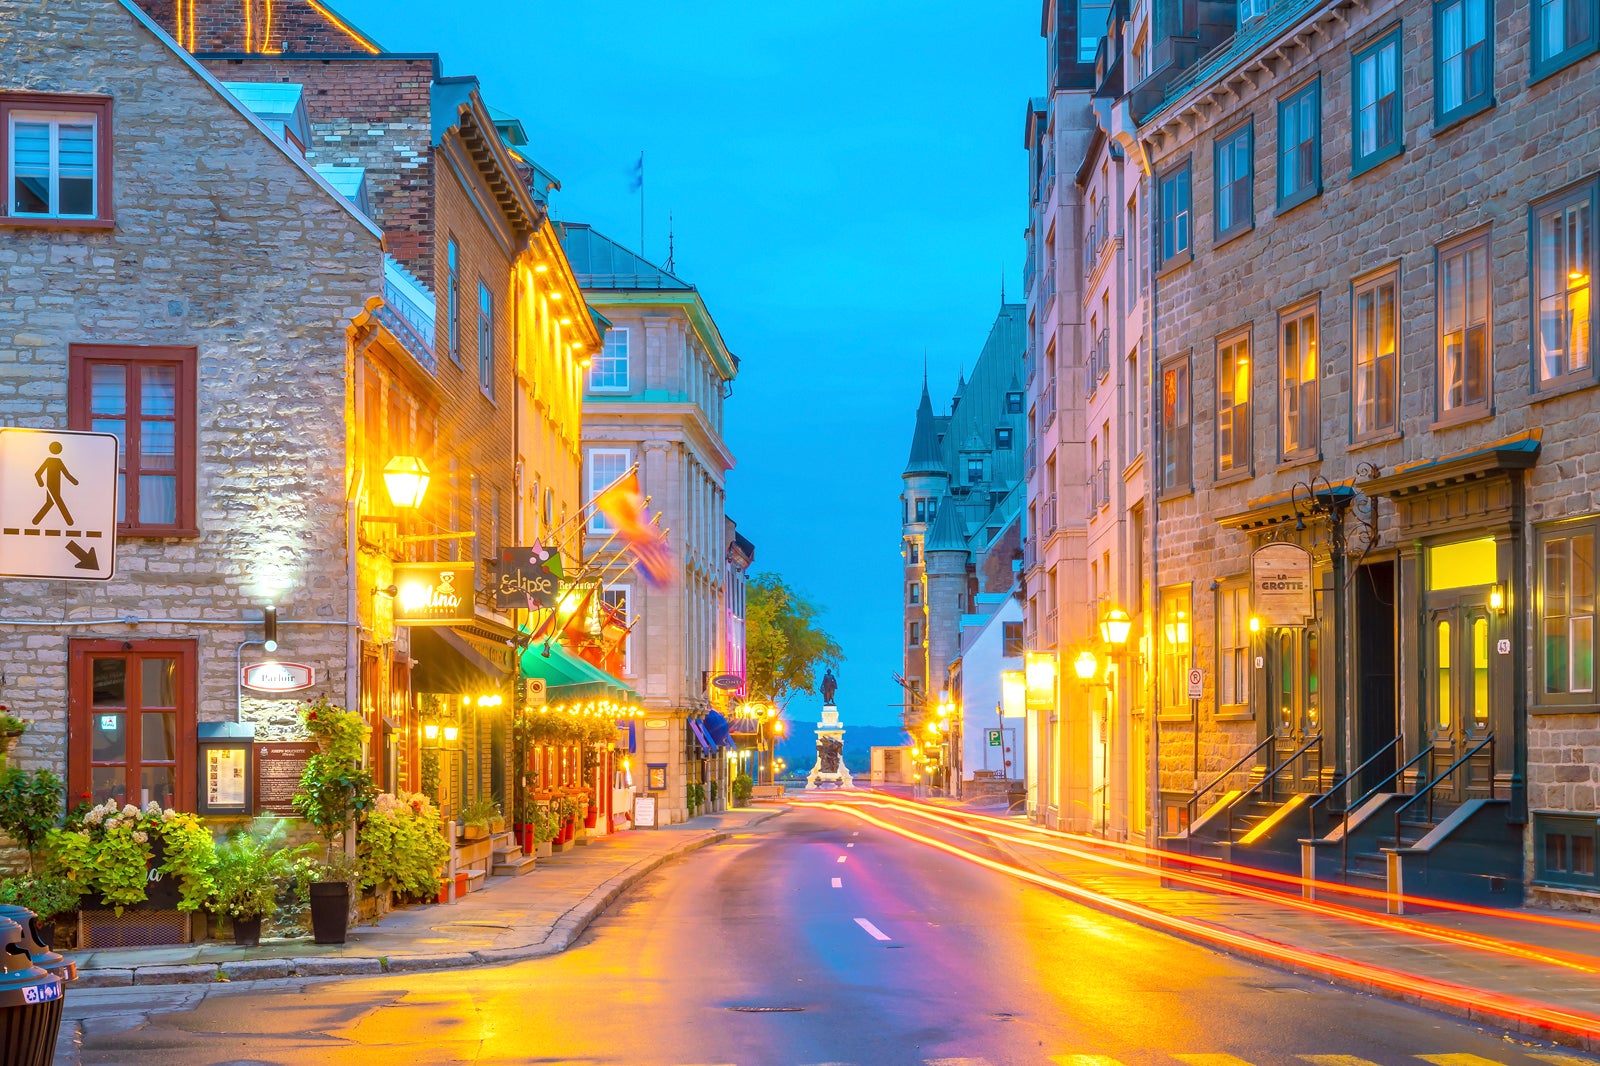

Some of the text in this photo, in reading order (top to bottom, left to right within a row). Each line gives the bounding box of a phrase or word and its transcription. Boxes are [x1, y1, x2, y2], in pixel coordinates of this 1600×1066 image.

[500, 568, 552, 595] Eclipse
[1261, 581, 1303, 590] GROTTE
[1499, 641, 1507, 652] 43
[991, 731, 999, 741] P
